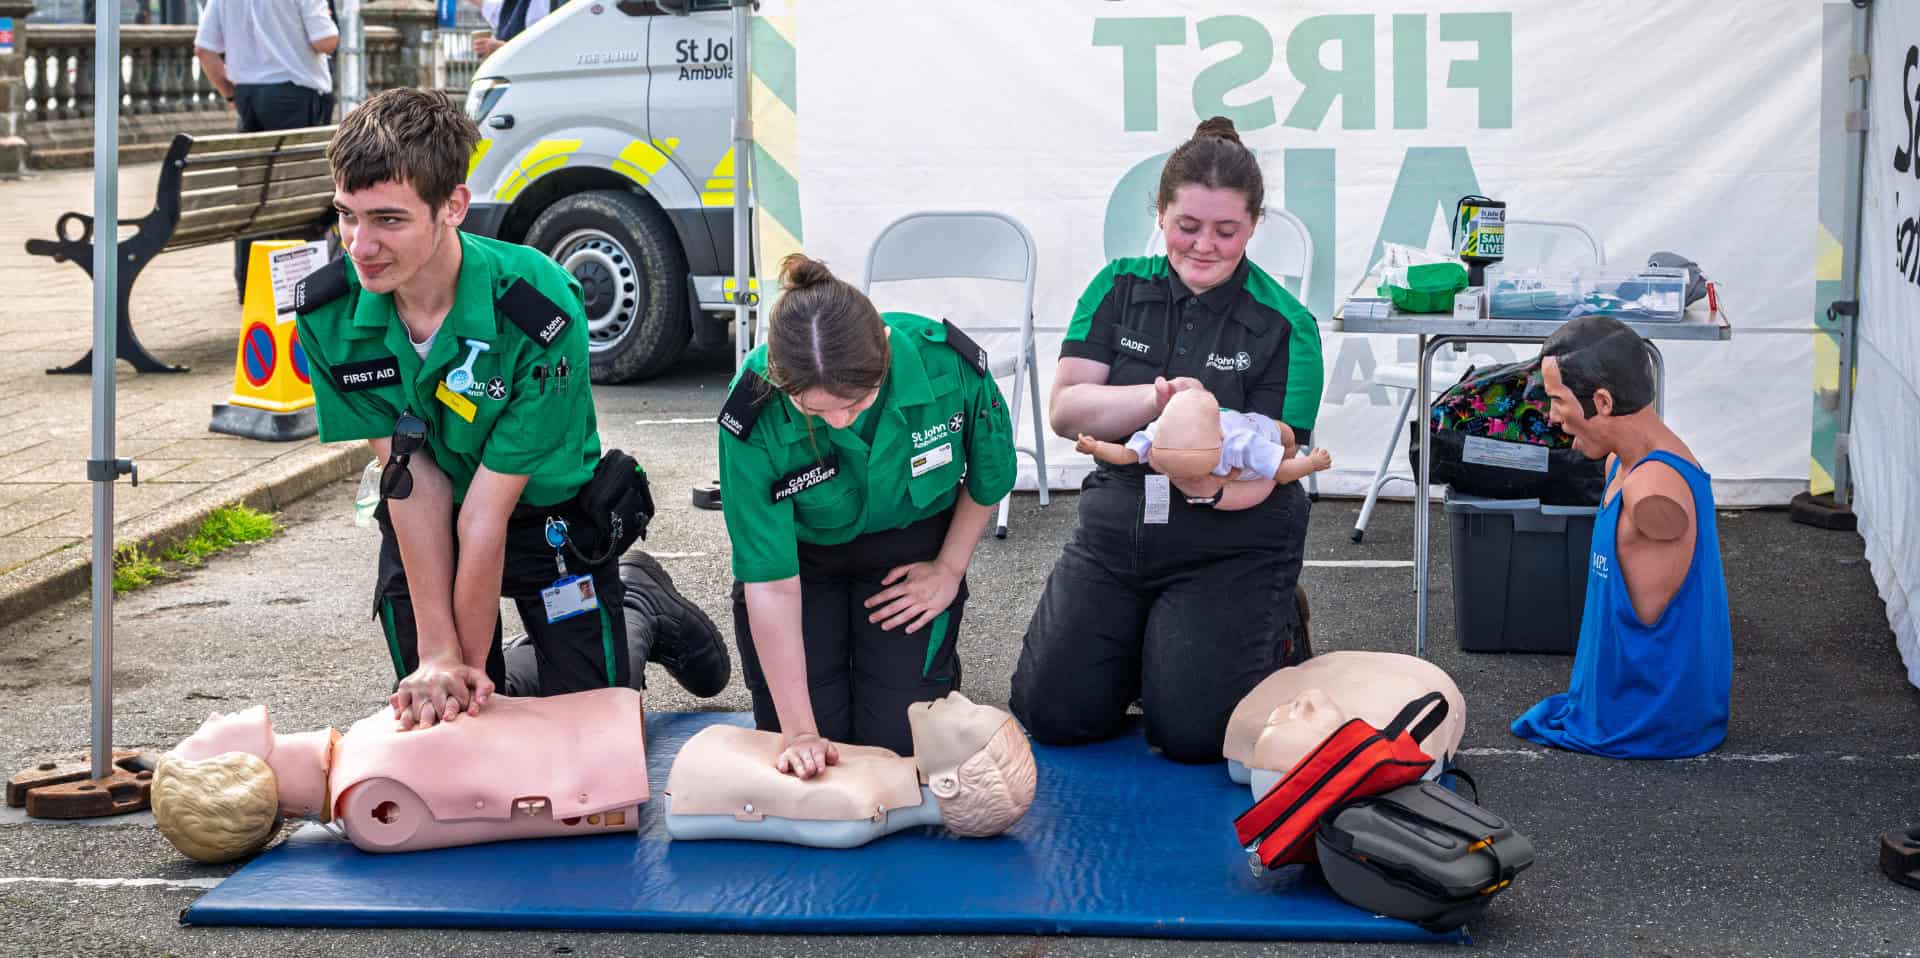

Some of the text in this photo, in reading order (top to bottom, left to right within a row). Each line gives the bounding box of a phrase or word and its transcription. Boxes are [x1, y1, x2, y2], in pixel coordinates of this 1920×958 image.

[675, 37, 733, 63] St Jo
[678, 64, 733, 81] Ambula
[1120, 337, 1150, 354] CADET
[343, 368, 396, 385] FIRST AID
[911, 423, 947, 443] St John
[775, 467, 836, 501] FIRST AIDER
[788, 466, 822, 488] CADET
